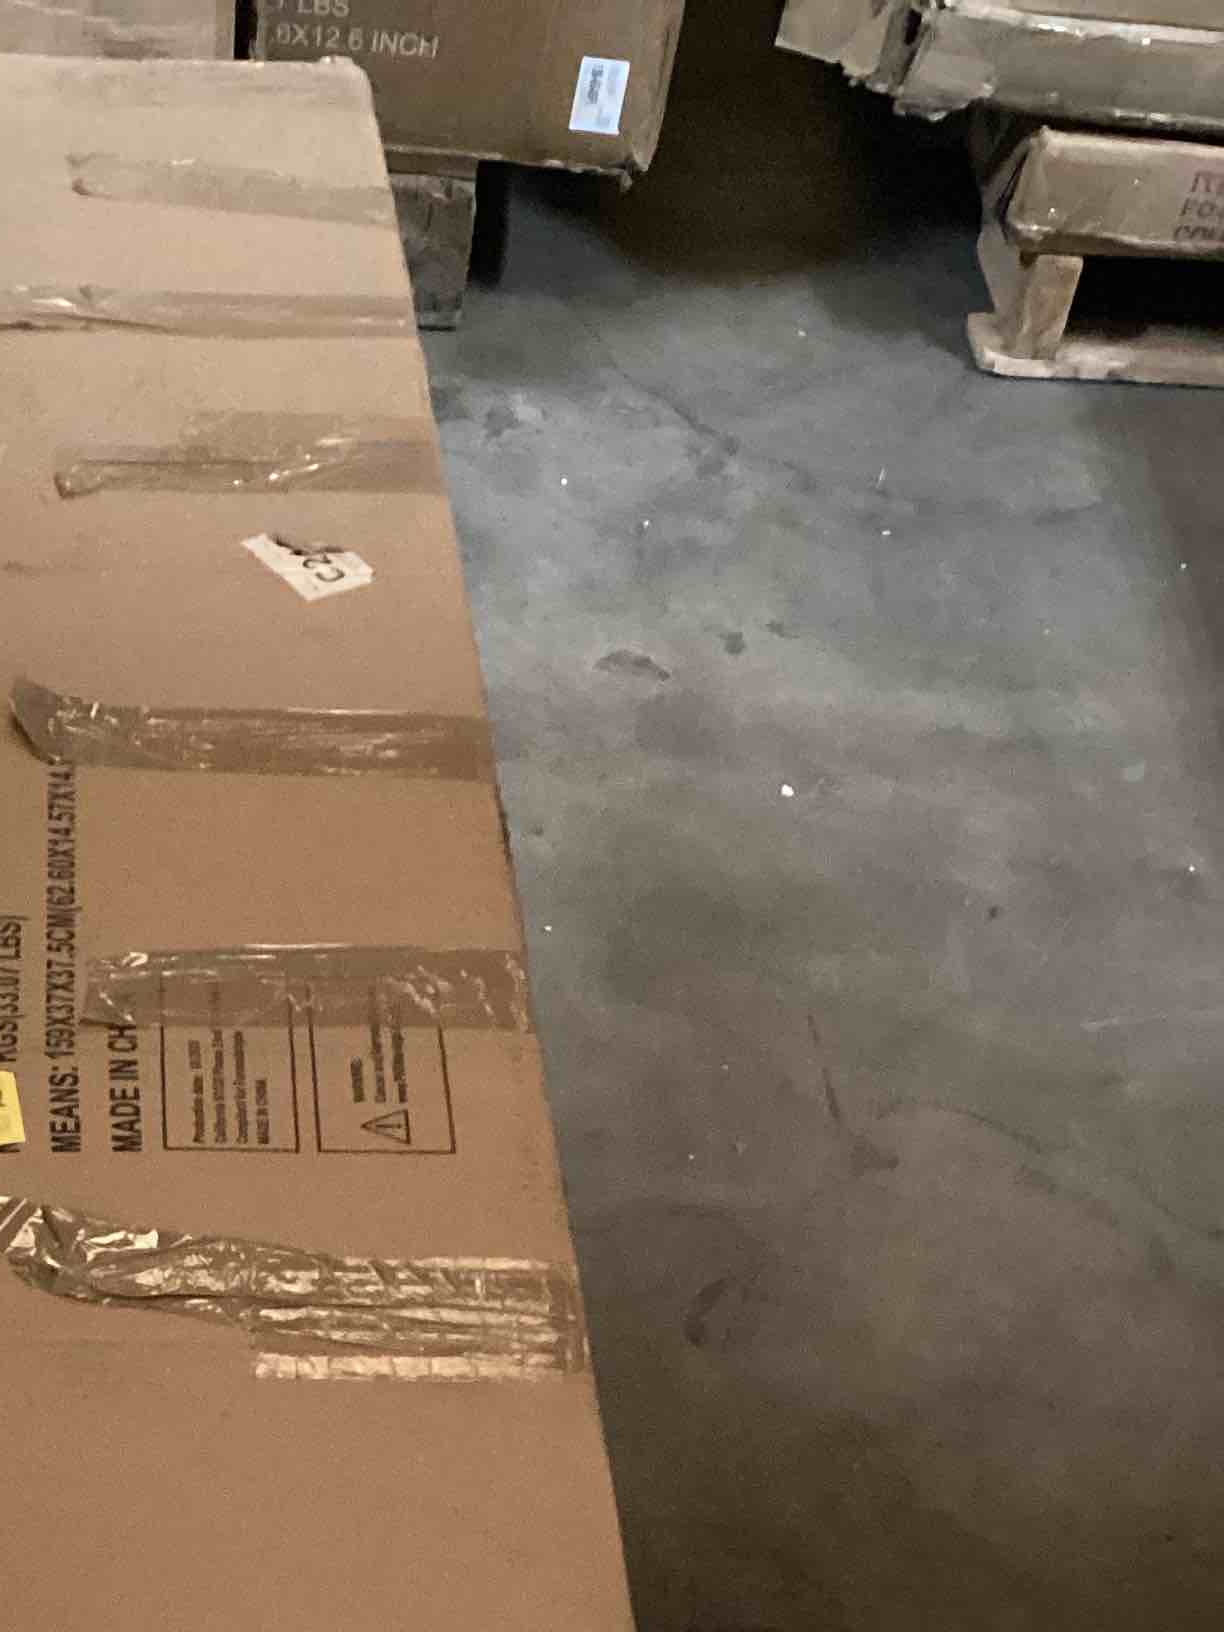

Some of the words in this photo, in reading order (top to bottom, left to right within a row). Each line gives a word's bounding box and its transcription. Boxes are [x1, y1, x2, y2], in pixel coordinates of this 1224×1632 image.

[370, 29, 440, 59] INCH
[109, 1059, 139, 1081] IN
[49, 1065, 81, 1152] MEANS:
[109, 1086, 142, 1153] MADE
